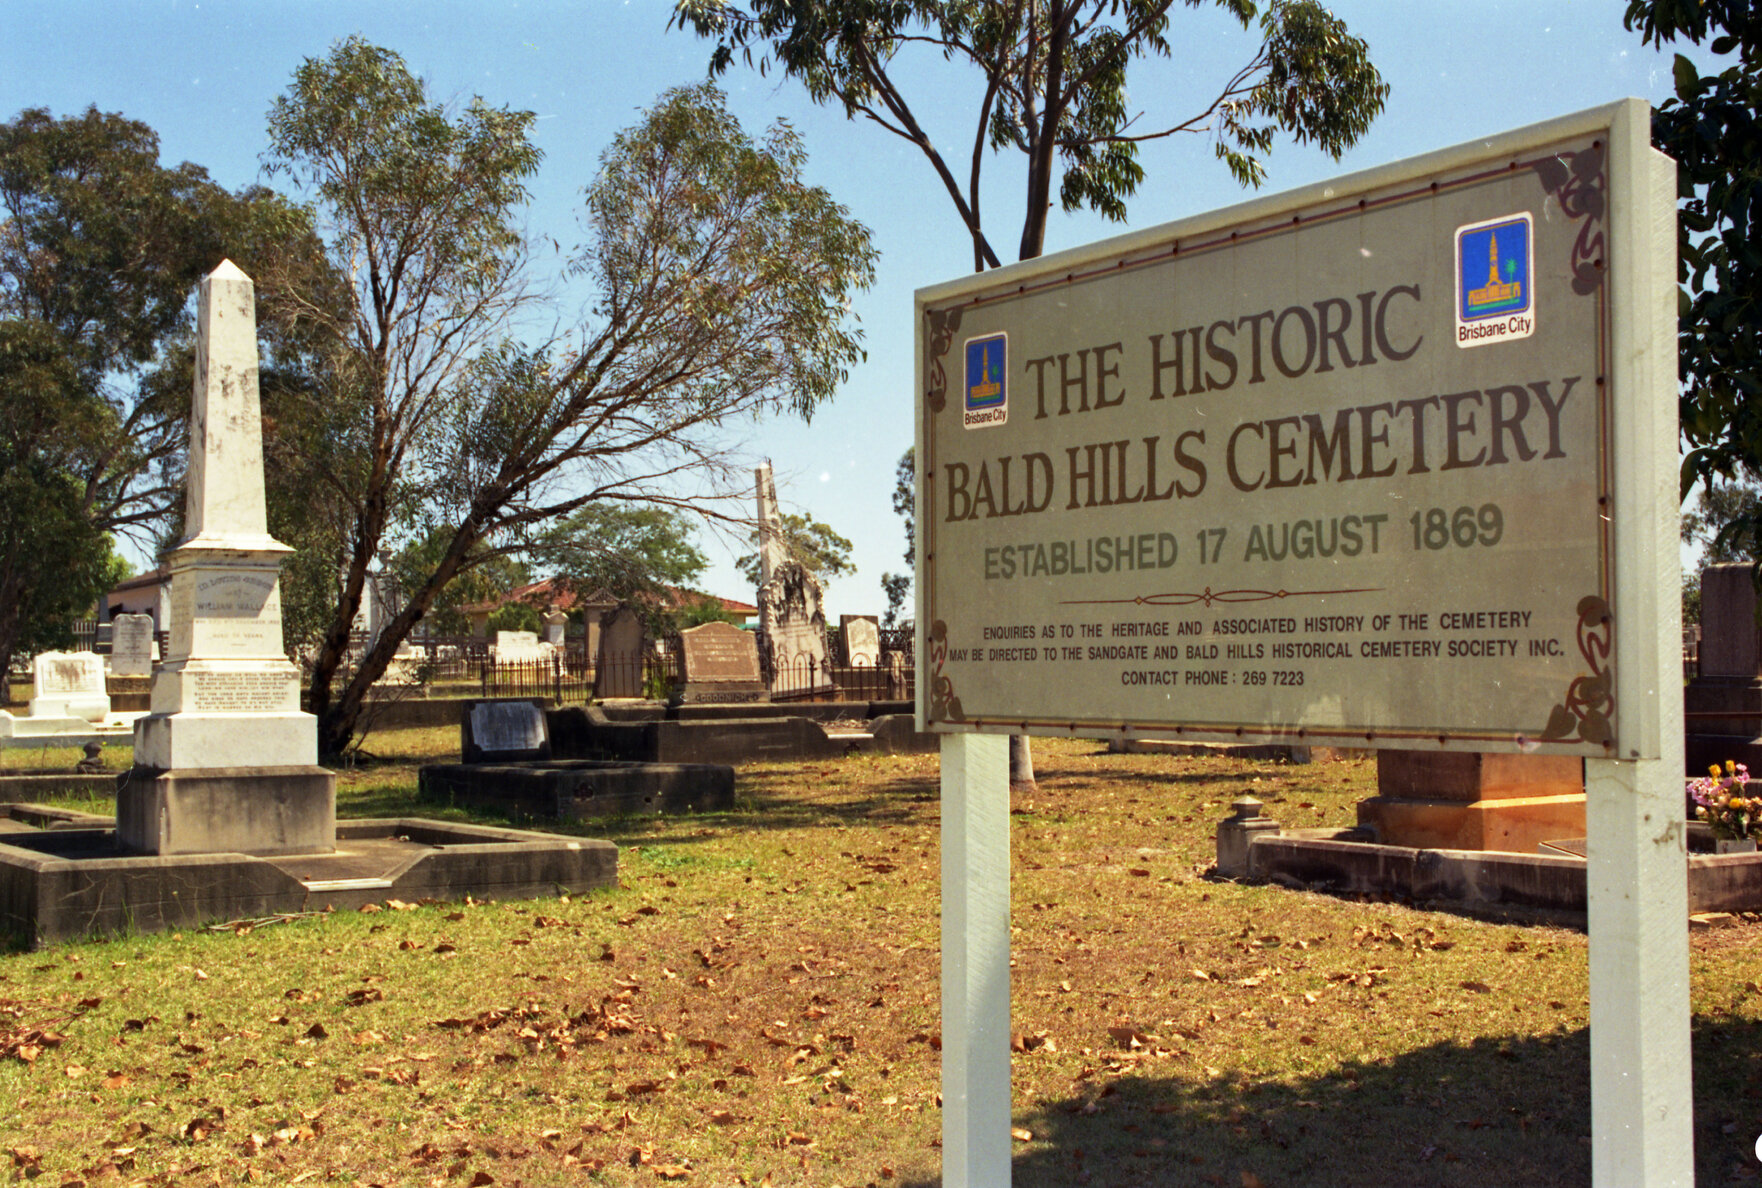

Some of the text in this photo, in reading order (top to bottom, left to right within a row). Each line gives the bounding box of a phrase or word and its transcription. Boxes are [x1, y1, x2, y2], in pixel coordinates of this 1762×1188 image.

[1459, 317, 1531, 341] Brisbane City
[1025, 283, 1424, 420] THE HISTORIC
[965, 408, 1006, 425] Brisbane City
[944, 376, 1582, 523] BALD HILLS CEMETERY
[984, 503, 1504, 580] ESTABLISHED 17 AUGUST 1869
[983, 611, 1532, 640] ENQUIRIES AS TO THE HERITAGE AND ASSOCIATED HISTORY OF THE CEMETERY
[950, 639, 1565, 662] MAY BE DIRECTED TO THE SANDGATE AND BALD HILLS HISTORICAL CEMETERY SOCIETY INC.
[1121, 671, 1178, 686] CONTACT
[1242, 669, 1267, 685] 269
[1272, 671, 1304, 686] 7223
